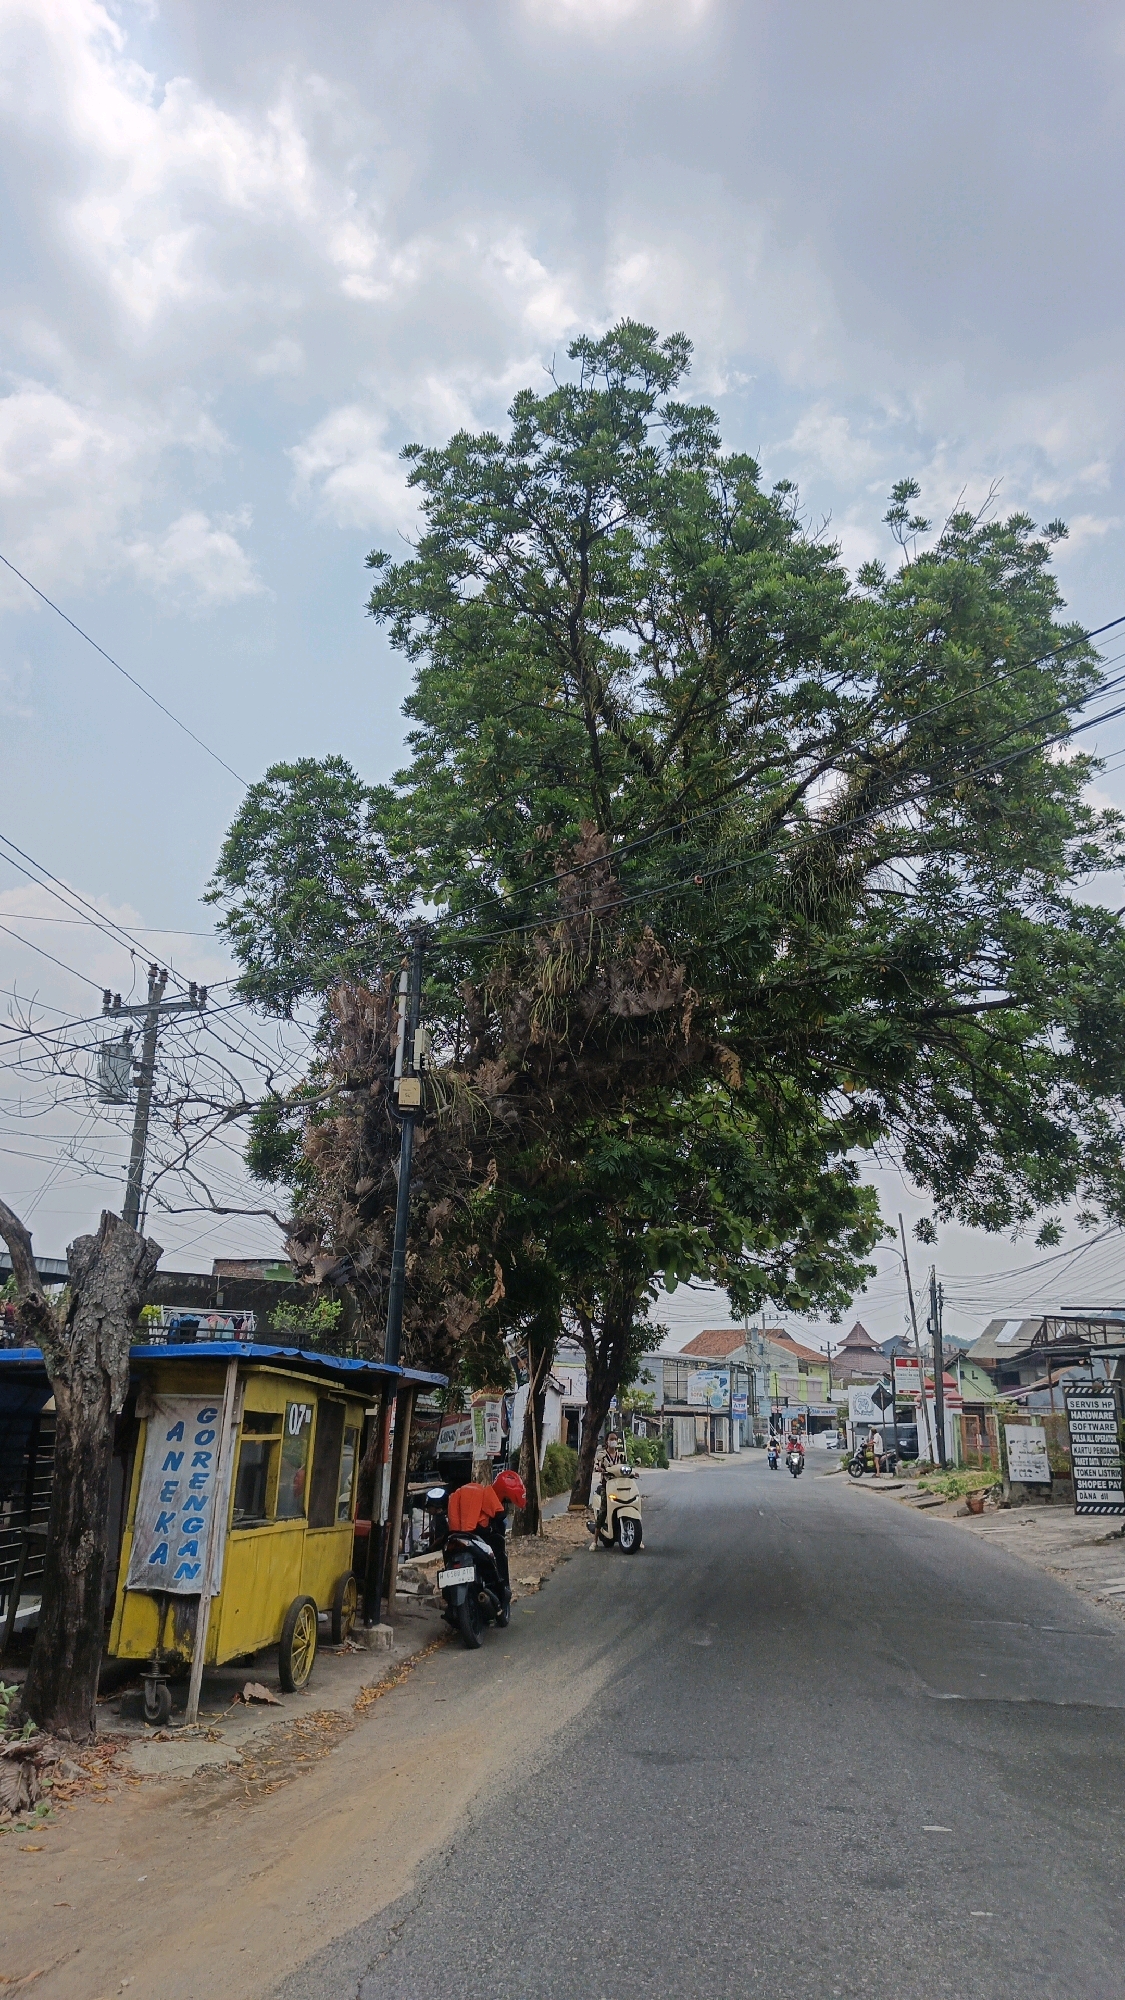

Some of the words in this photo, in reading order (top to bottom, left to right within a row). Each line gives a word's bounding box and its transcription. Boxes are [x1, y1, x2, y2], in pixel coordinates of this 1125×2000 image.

[1070, 1400, 1100, 1408] SERVIS
[1102, 1401, 1113, 1409] HP
[1071, 1411, 1114, 1420] HARDWARE
[1072, 1422, 1115, 1431] SOFTWARE
[1072, 1434, 1086, 1442] PULSA
[1086, 1434, 1095, 1443] ALL
[1095, 1434, 1117, 1443] OPERATOR
[1073, 1446, 1092, 1454] KARTU
[1093, 1446, 1118, 1455] PERDANA
[1075, 1457, 1088, 1466] PAKET
[1089, 1457, 1100, 1466] DATA
[1077, 1469, 1097, 1477] TOKEN
[1098, 1469, 1122, 1478] LISTRIK
[1077, 1480, 1107, 1489] SHOPEE
[1108, 1481, 1122, 1489] PAY
[149, 1420, 185, 1565] ANEKA
[174, 1407, 218, 1580] GORENGAN
[1079, 1492, 1097, 1500] DANA
[1100, 1492, 1109, 1500] dll
